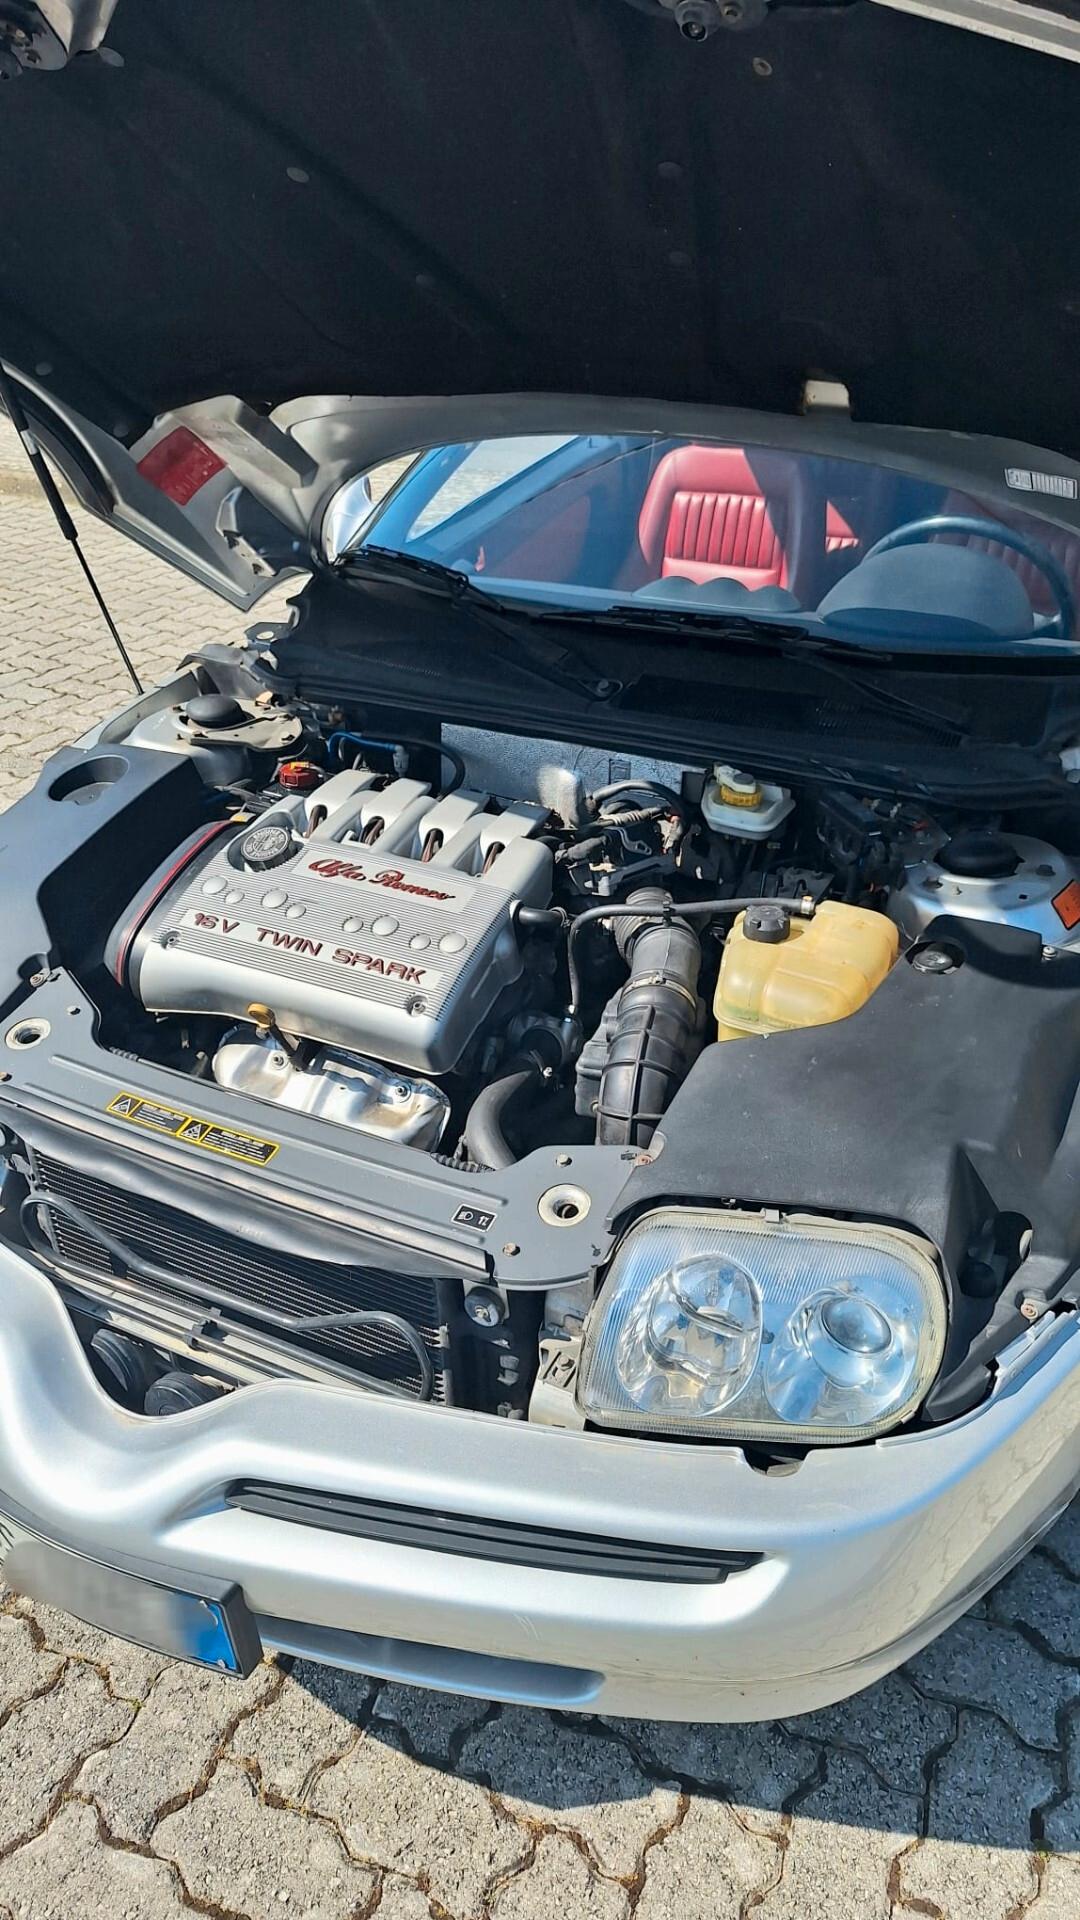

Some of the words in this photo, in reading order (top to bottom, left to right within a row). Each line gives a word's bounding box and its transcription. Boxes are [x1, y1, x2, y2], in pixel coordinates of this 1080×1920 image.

[308, 858, 366, 878] Alfa
[369, 869, 456, 900] Romeo
[257, 927, 323, 957] TWIN
[332, 948, 427, 985] SPARK
